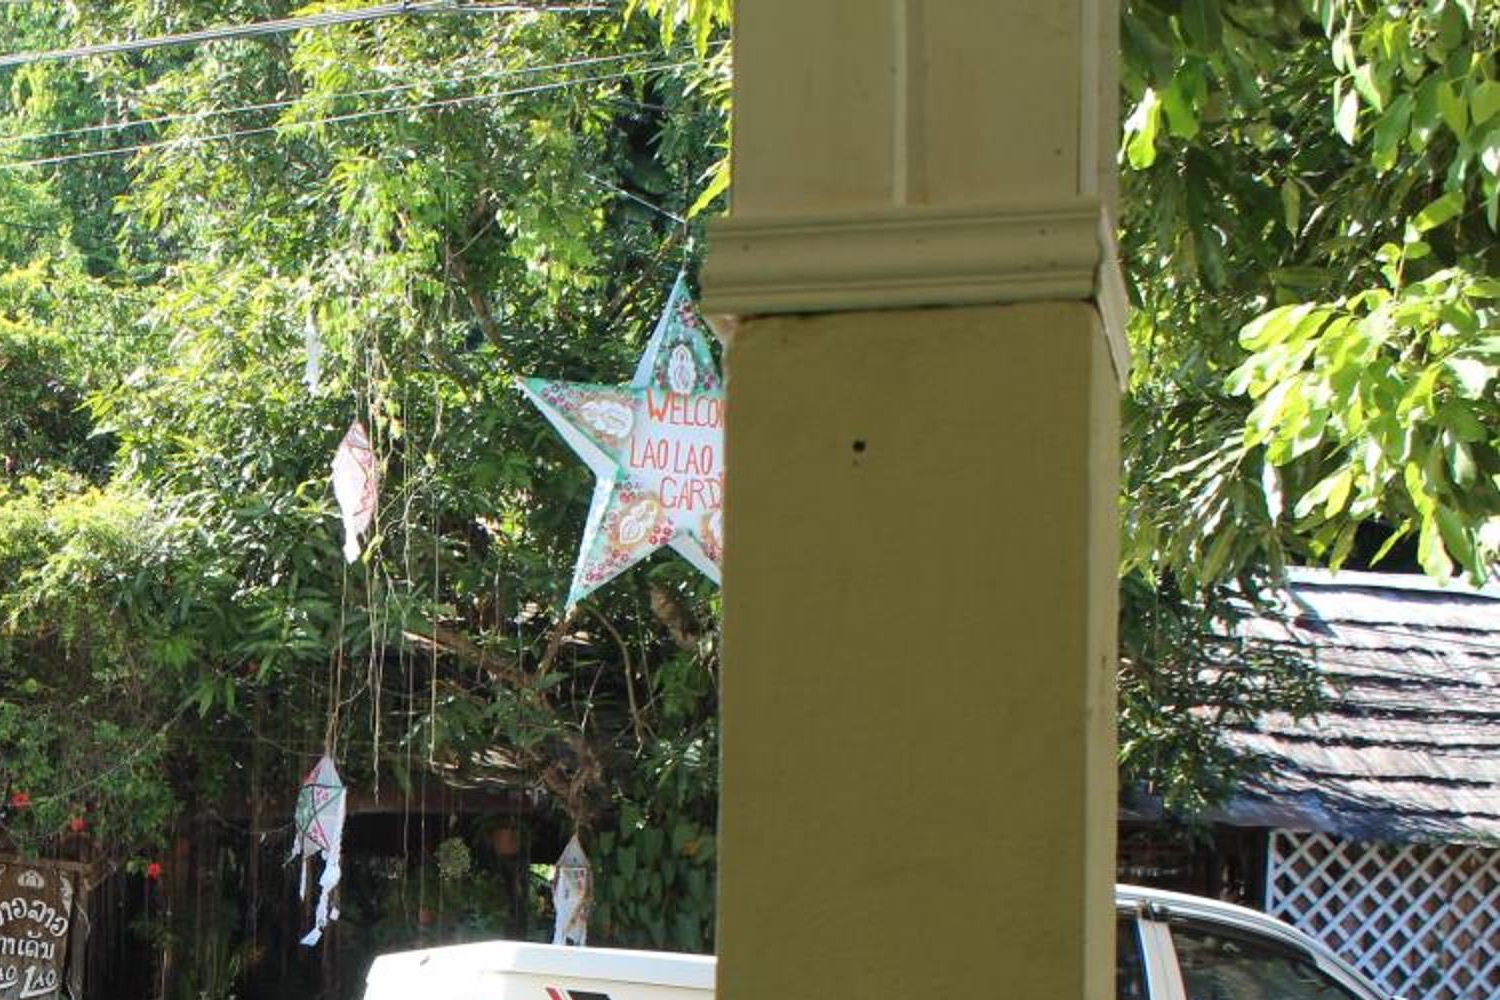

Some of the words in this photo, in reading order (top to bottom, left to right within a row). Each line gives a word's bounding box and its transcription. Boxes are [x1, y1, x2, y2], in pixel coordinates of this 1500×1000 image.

[646, 388, 723, 428] WELCO
[629, 435, 669, 470] LAO
[674, 440, 713, 475] LAO
[660, 475, 723, 510] GARD
[20, 966, 60, 999] LAO
